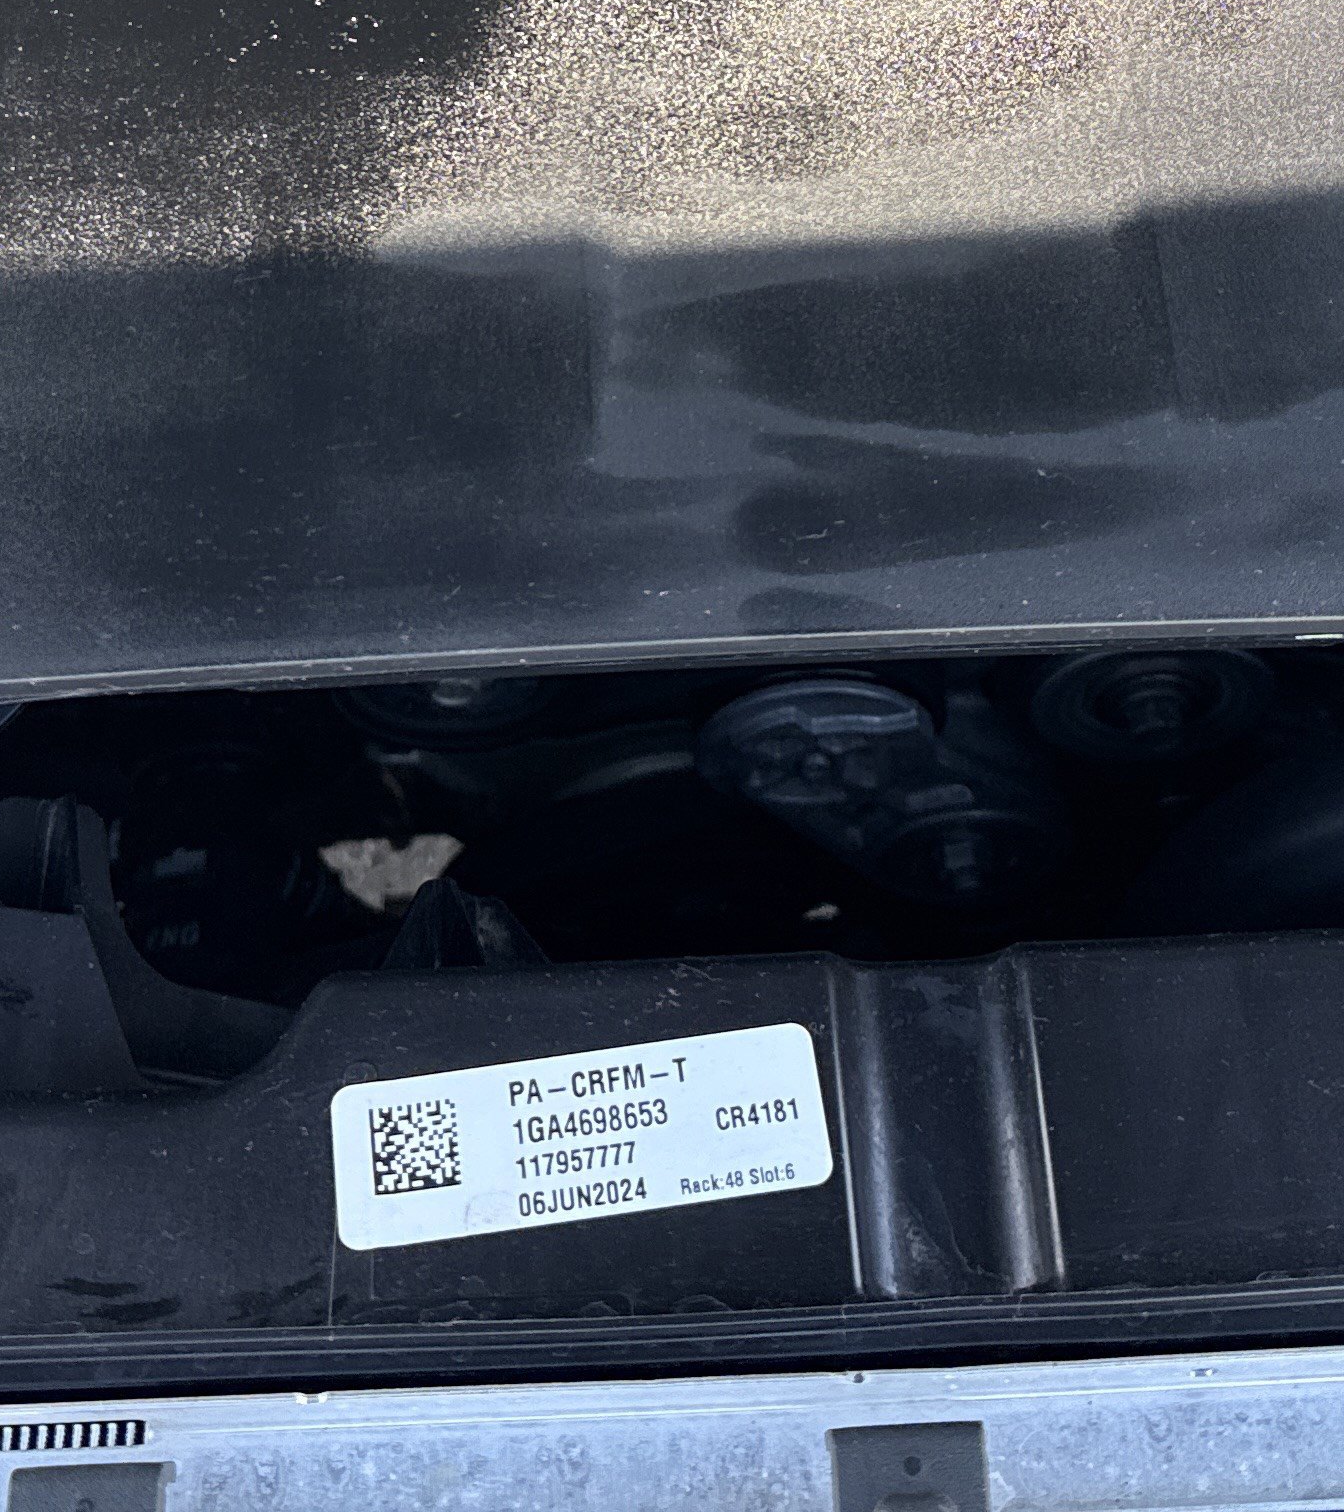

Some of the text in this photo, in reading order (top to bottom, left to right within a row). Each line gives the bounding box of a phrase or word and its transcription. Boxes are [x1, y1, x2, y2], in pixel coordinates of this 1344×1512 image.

[513, 1099, 668, 1145] 1GA4698653
[716, 1098, 799, 1130] CR4181
[516, 1142, 637, 1179] 117957777
[519, 1178, 648, 1217] 06JUN2024
[680, 1163, 795, 1196] Rack:48 Slot:6
